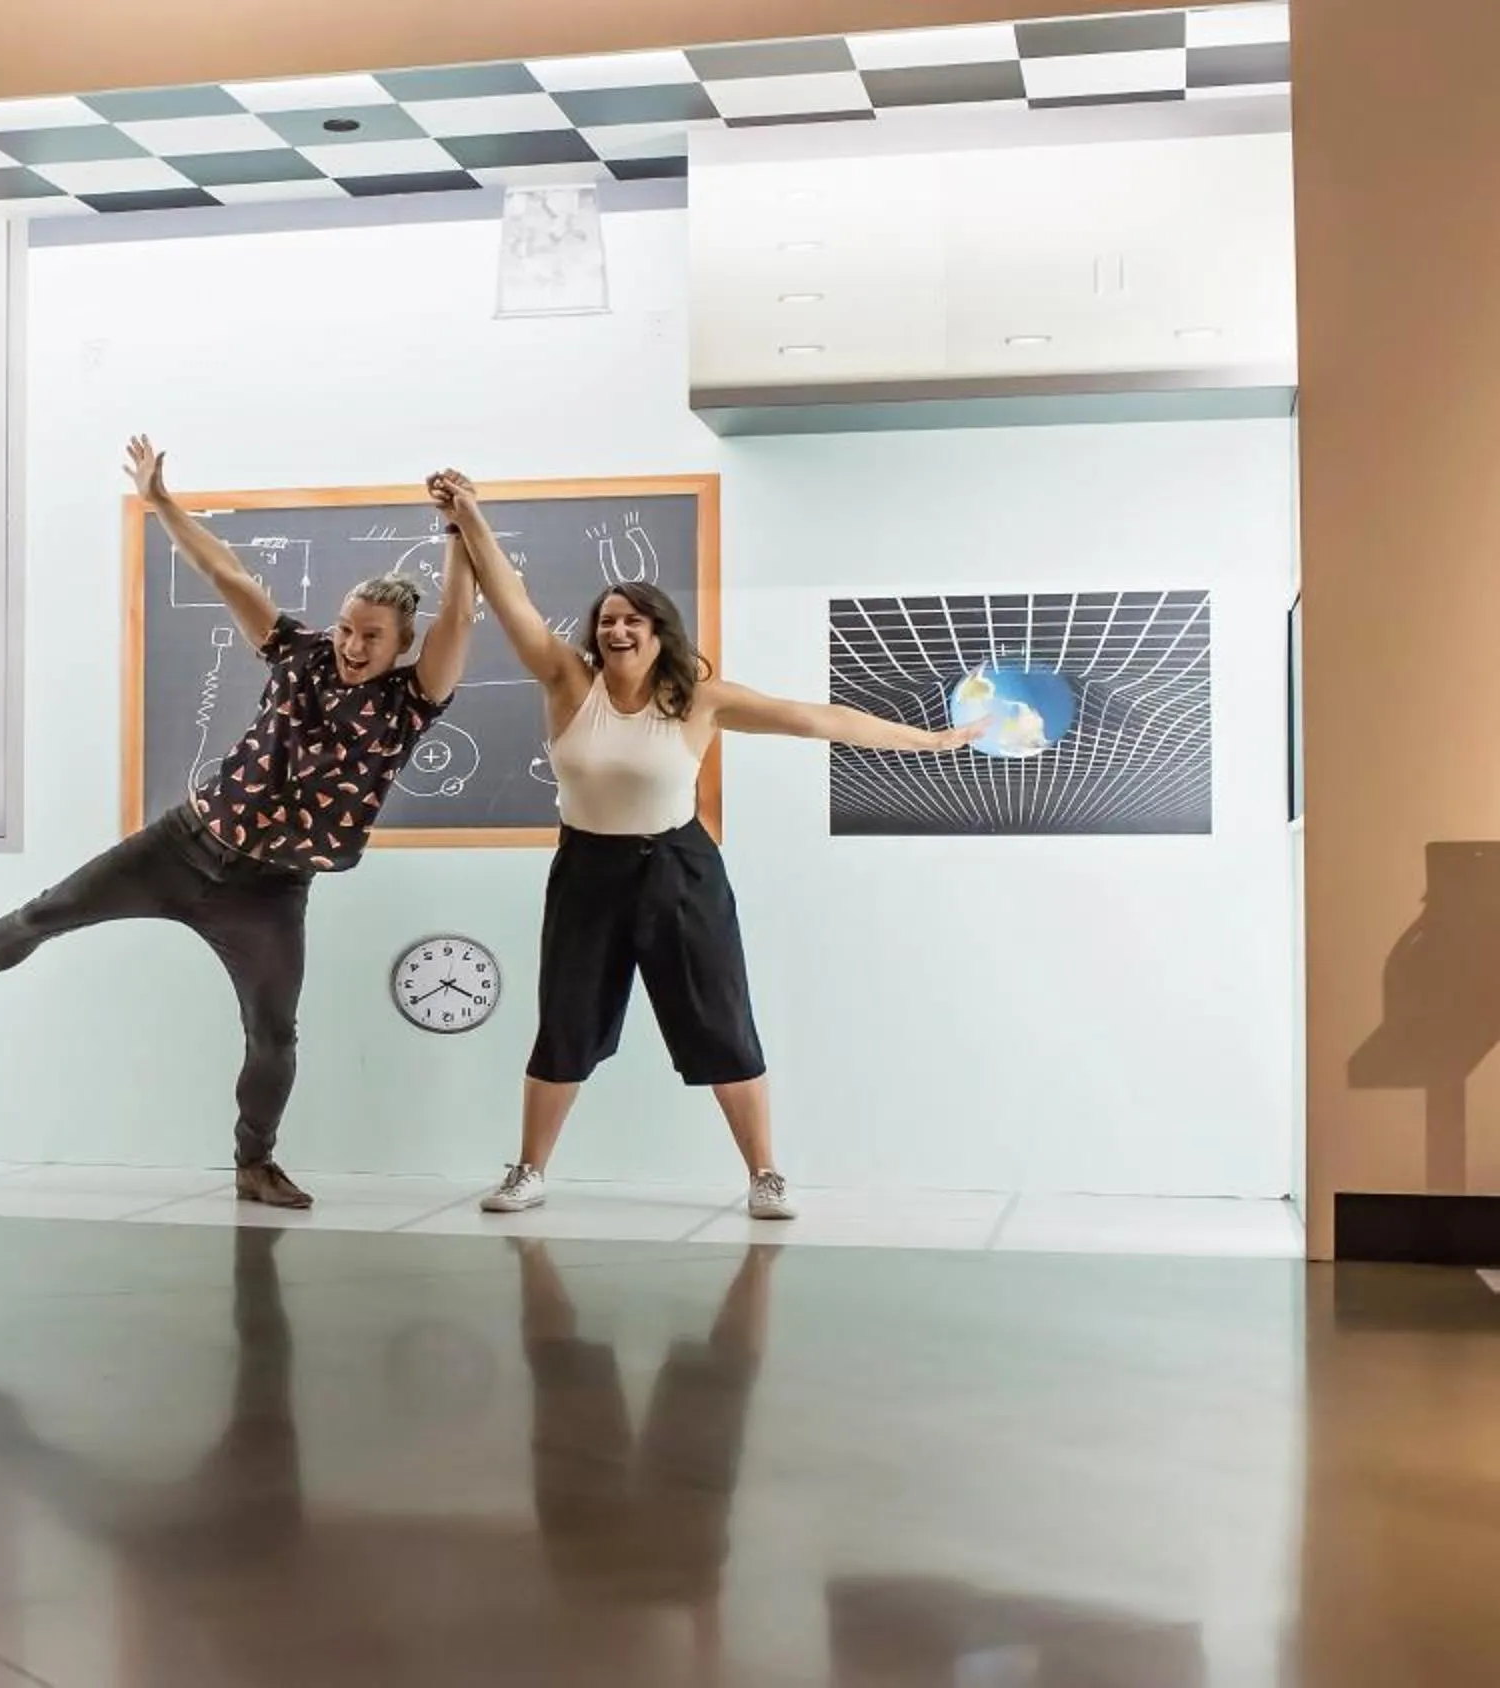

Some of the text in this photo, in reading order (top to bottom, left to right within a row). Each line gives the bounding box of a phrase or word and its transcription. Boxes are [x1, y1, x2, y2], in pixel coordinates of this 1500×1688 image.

[423, 951, 433, 960] 5
[443, 947, 453, 956] 6
[462, 951, 471, 960] 7
[410, 964, 419, 972] 4
[475, 963, 486, 973] 8
[404, 979, 414, 988] 3
[481, 980, 491, 989] 9
[473, 995, 487, 1005] 10
[427, 1009, 431, 1019] 1
[461, 1007, 471, 1017] 11
[442, 1012, 454, 1022] 12
